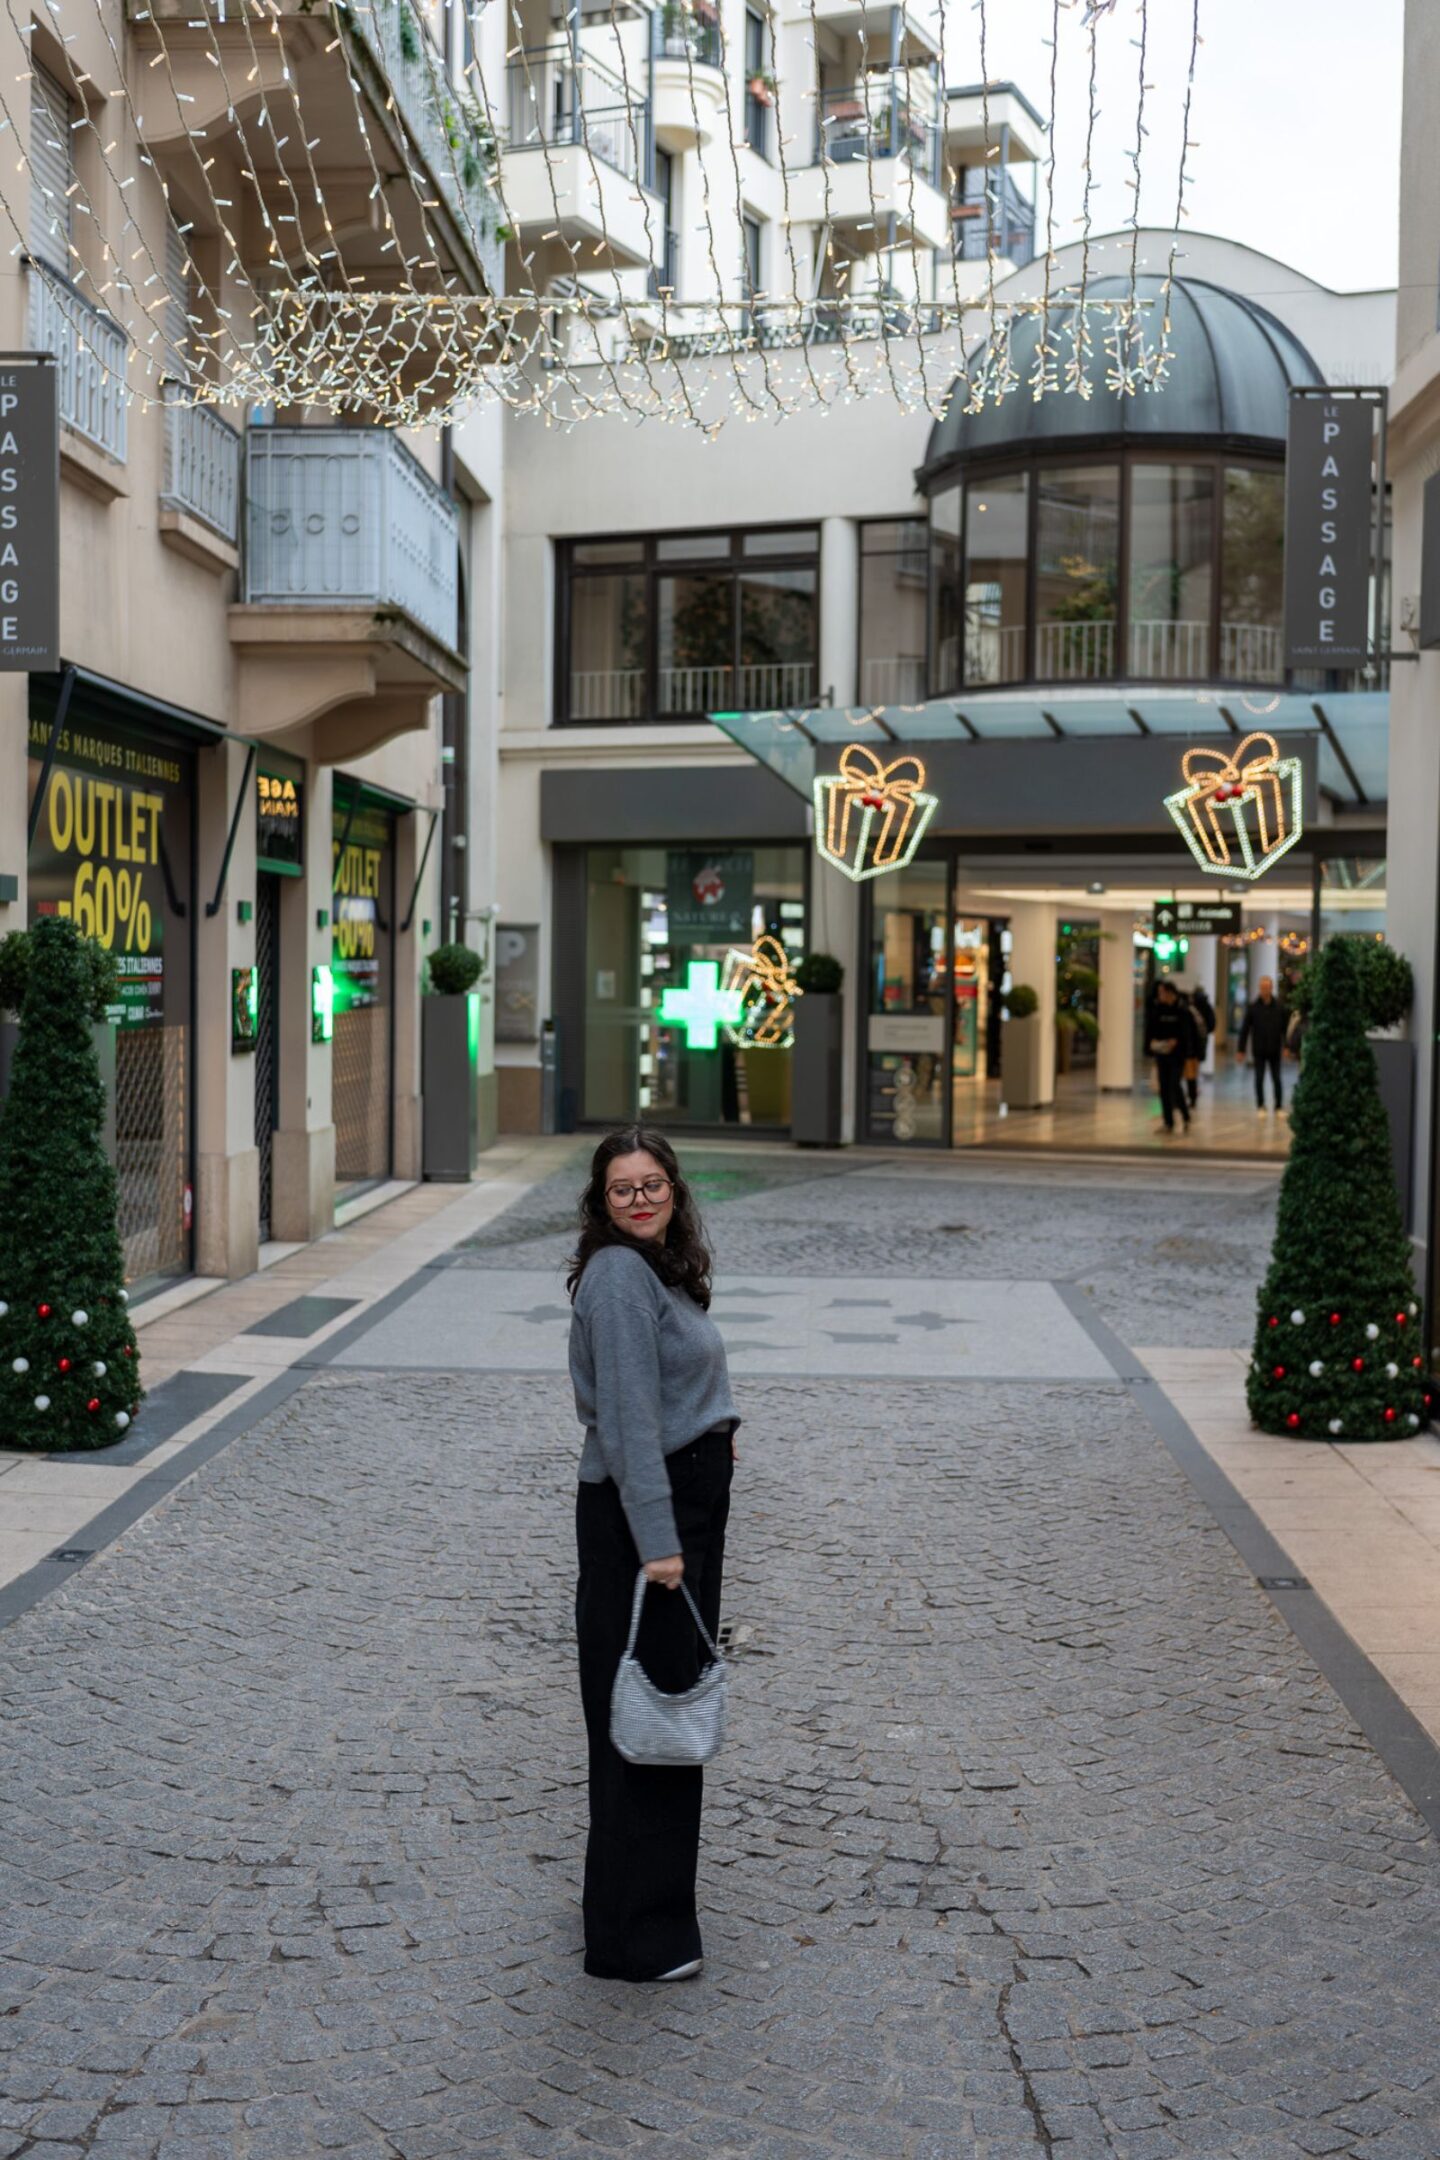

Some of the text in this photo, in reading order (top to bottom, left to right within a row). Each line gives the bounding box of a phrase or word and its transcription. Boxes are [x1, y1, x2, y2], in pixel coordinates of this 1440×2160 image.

[1, 376, 16, 387] LE
[1324, 406, 1339, 417] LE
[0, 394, 18, 640] PASSAGE
[1319, 422, 1340, 642] PASSAGE
[74, 733, 122, 767] MARQUES
[125, 750, 180, 783] ITALIENNES
[49, 770, 163, 866] OUTLET
[58, 861, 151, 953] -60%
